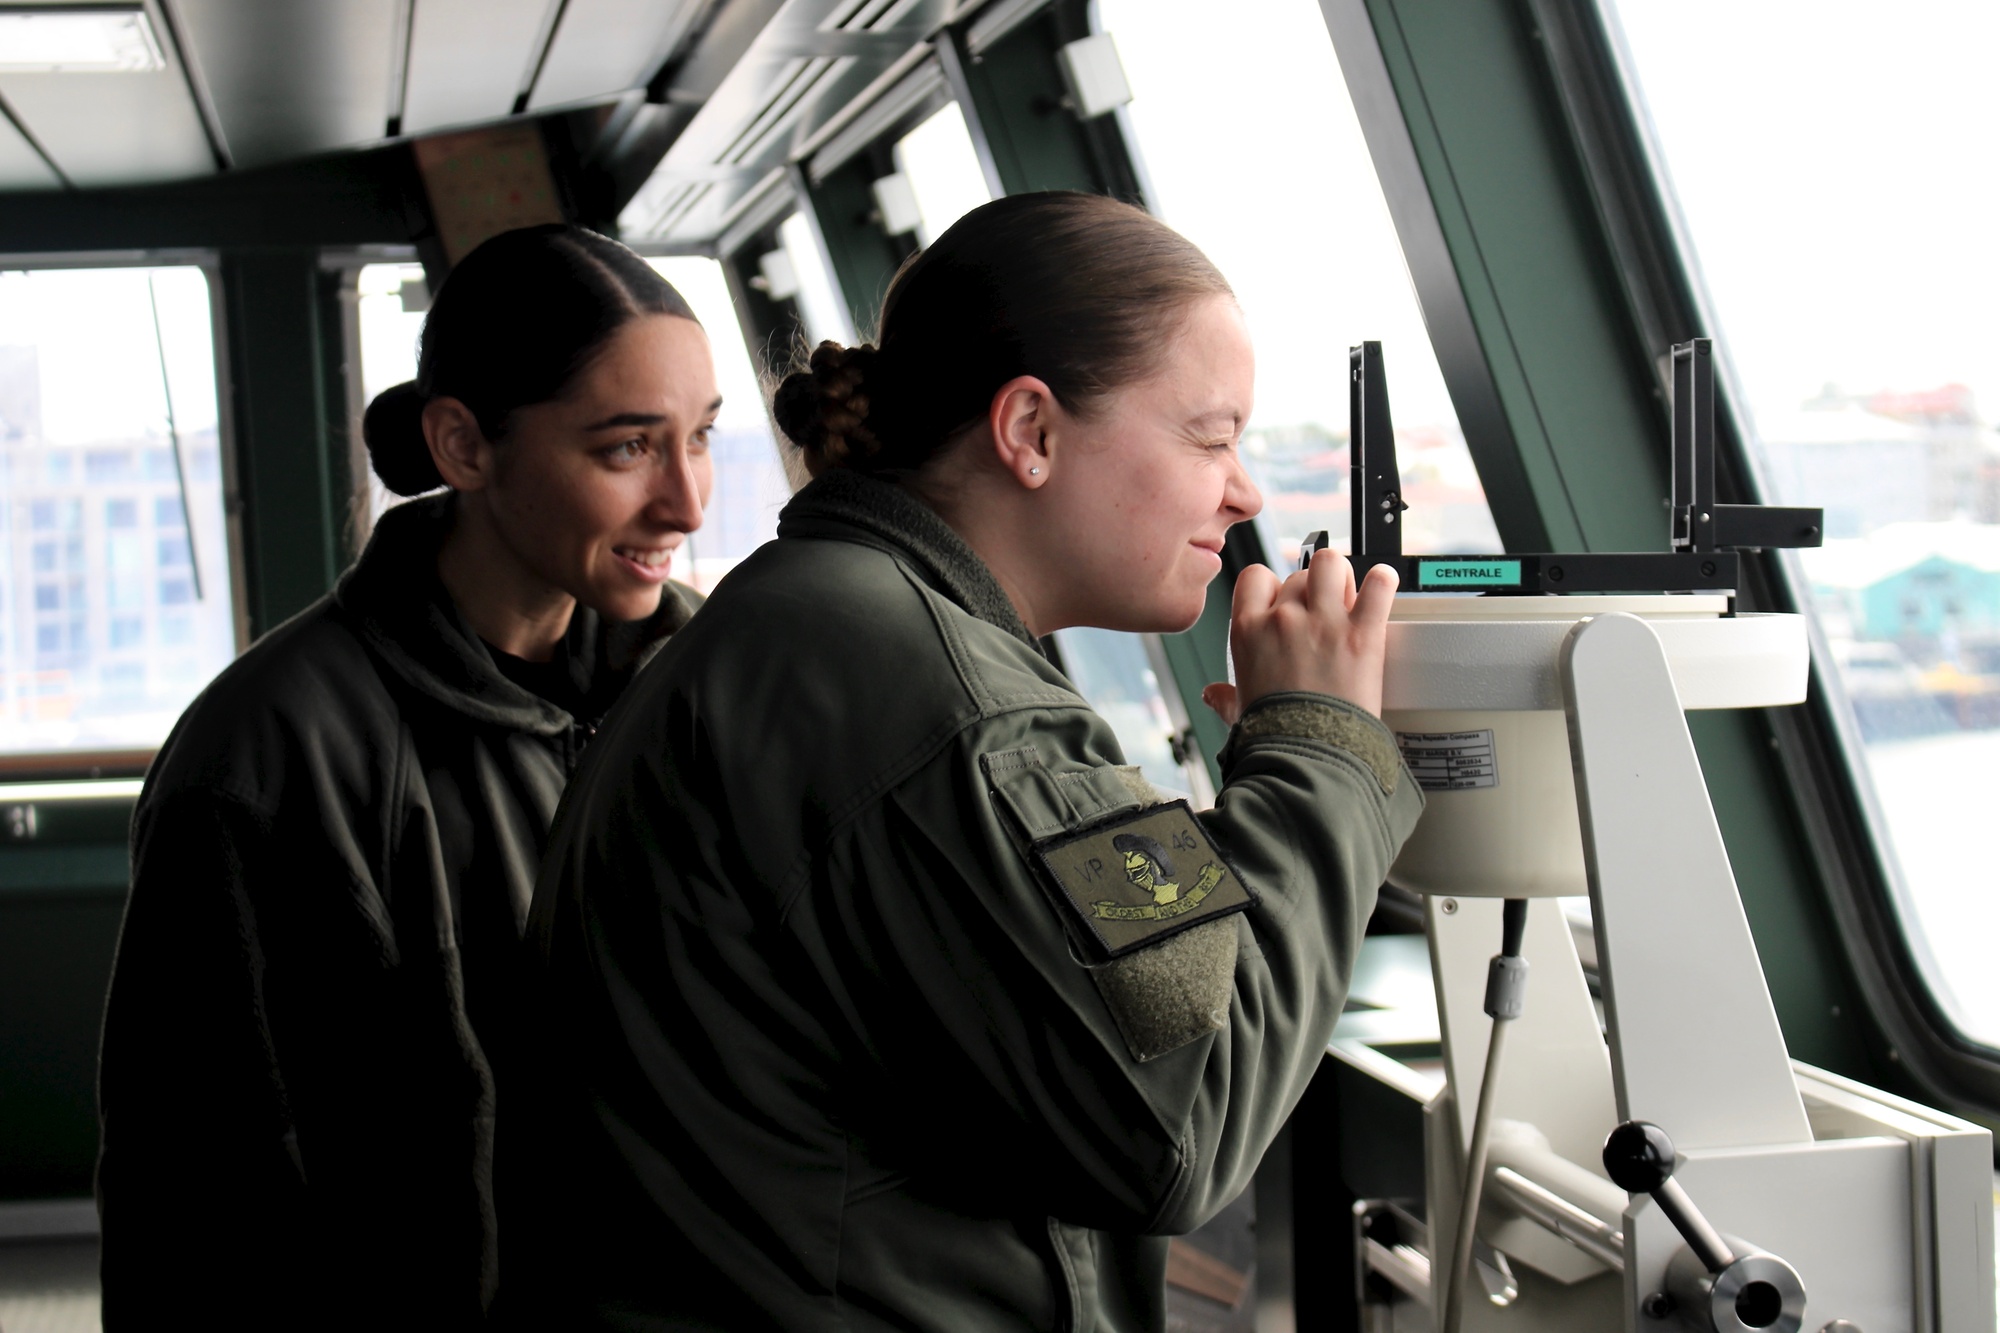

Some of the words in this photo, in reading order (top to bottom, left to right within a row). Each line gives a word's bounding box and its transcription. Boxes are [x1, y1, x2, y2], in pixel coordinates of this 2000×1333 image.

[1435, 568, 1502, 578] CENTRALE
[1450, 733, 1480, 741] Compass
[1073, 858, 1102, 883] VP
[1172, 829, 1197, 851] 46
[1105, 907, 1145, 918] OLDEST
[1159, 904, 1179, 918] AND
[1176, 898, 1194, 912] THE
